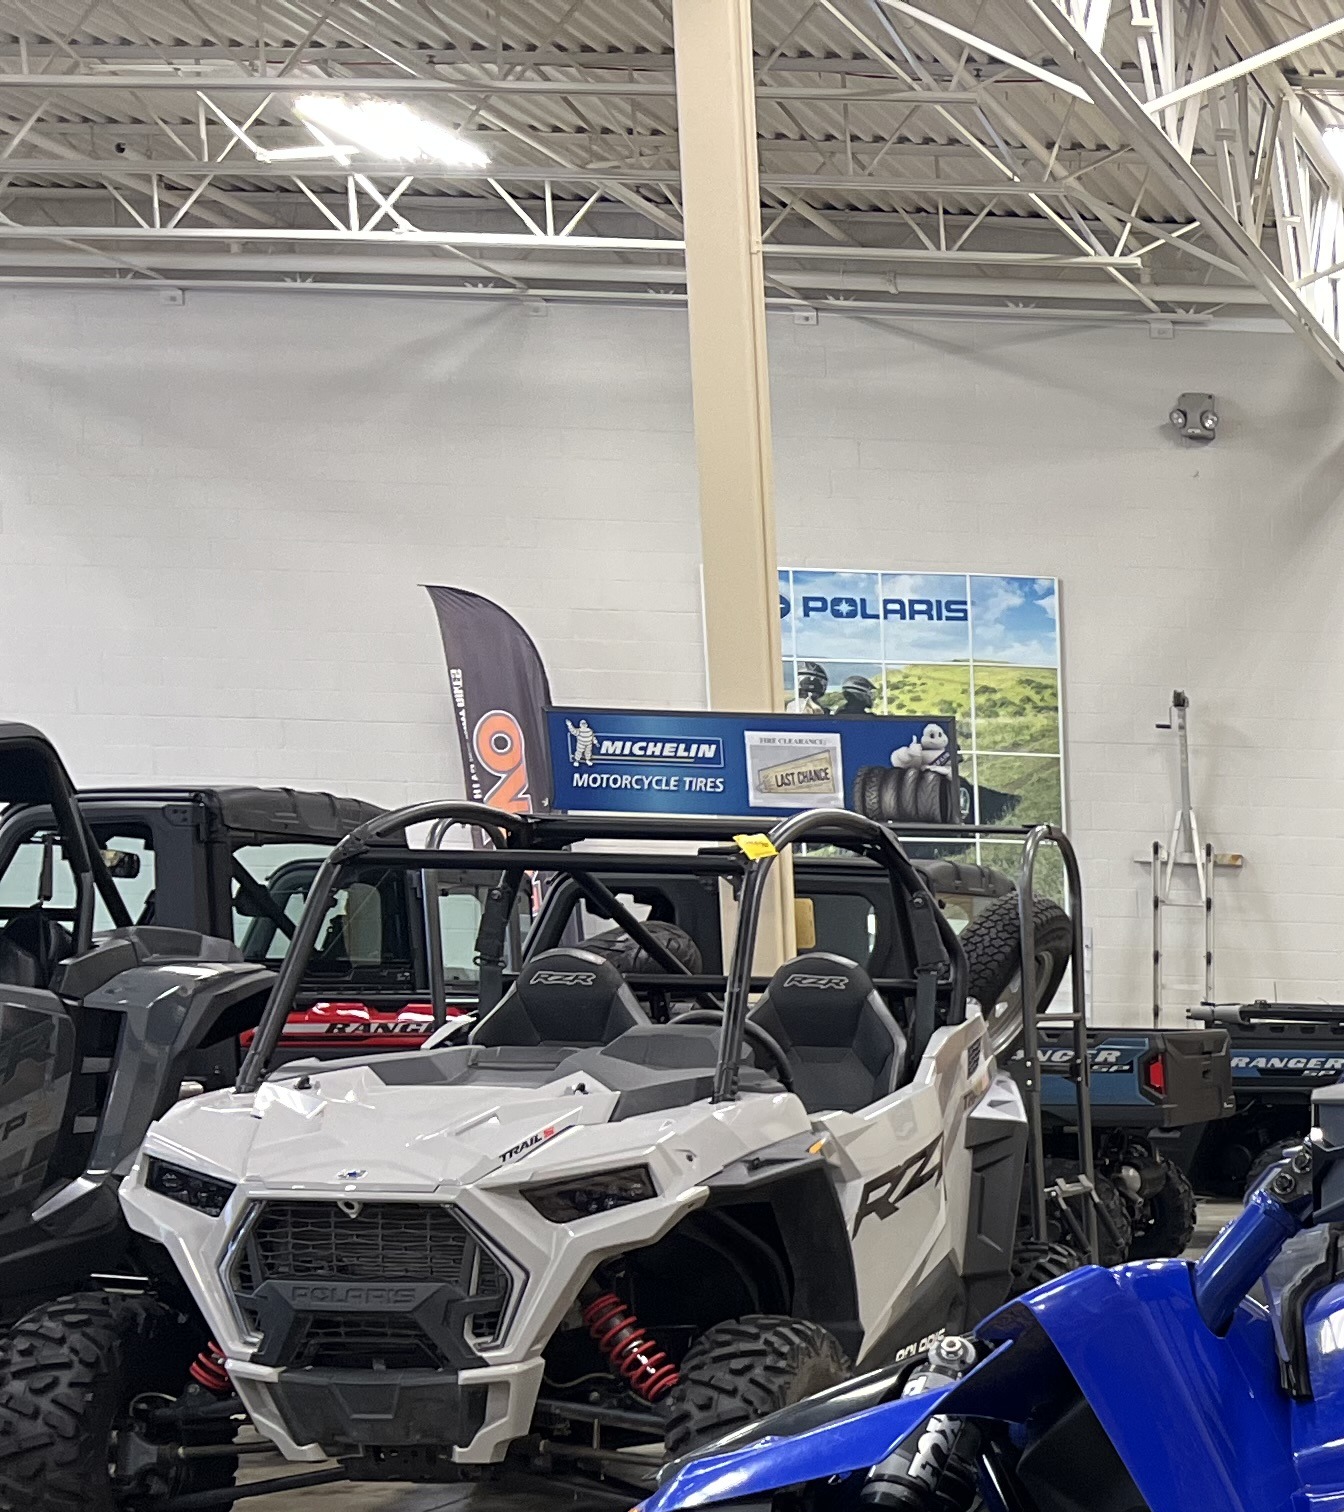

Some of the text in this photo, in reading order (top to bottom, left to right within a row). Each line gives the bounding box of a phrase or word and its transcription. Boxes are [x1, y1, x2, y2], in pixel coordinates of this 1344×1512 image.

[802, 596, 969, 622] POLARIS
[600, 740, 717, 758] MICHELIN
[573, 773, 725, 793] MOTORCYCLE TIRES
[775, 767, 830, 788] LAST CHANCE
[530, 971, 597, 985] RZR
[783, 974, 849, 989] RZR
[499, 1134, 543, 1163] TRAIL
[292, 1286, 416, 1304] POLARIS
